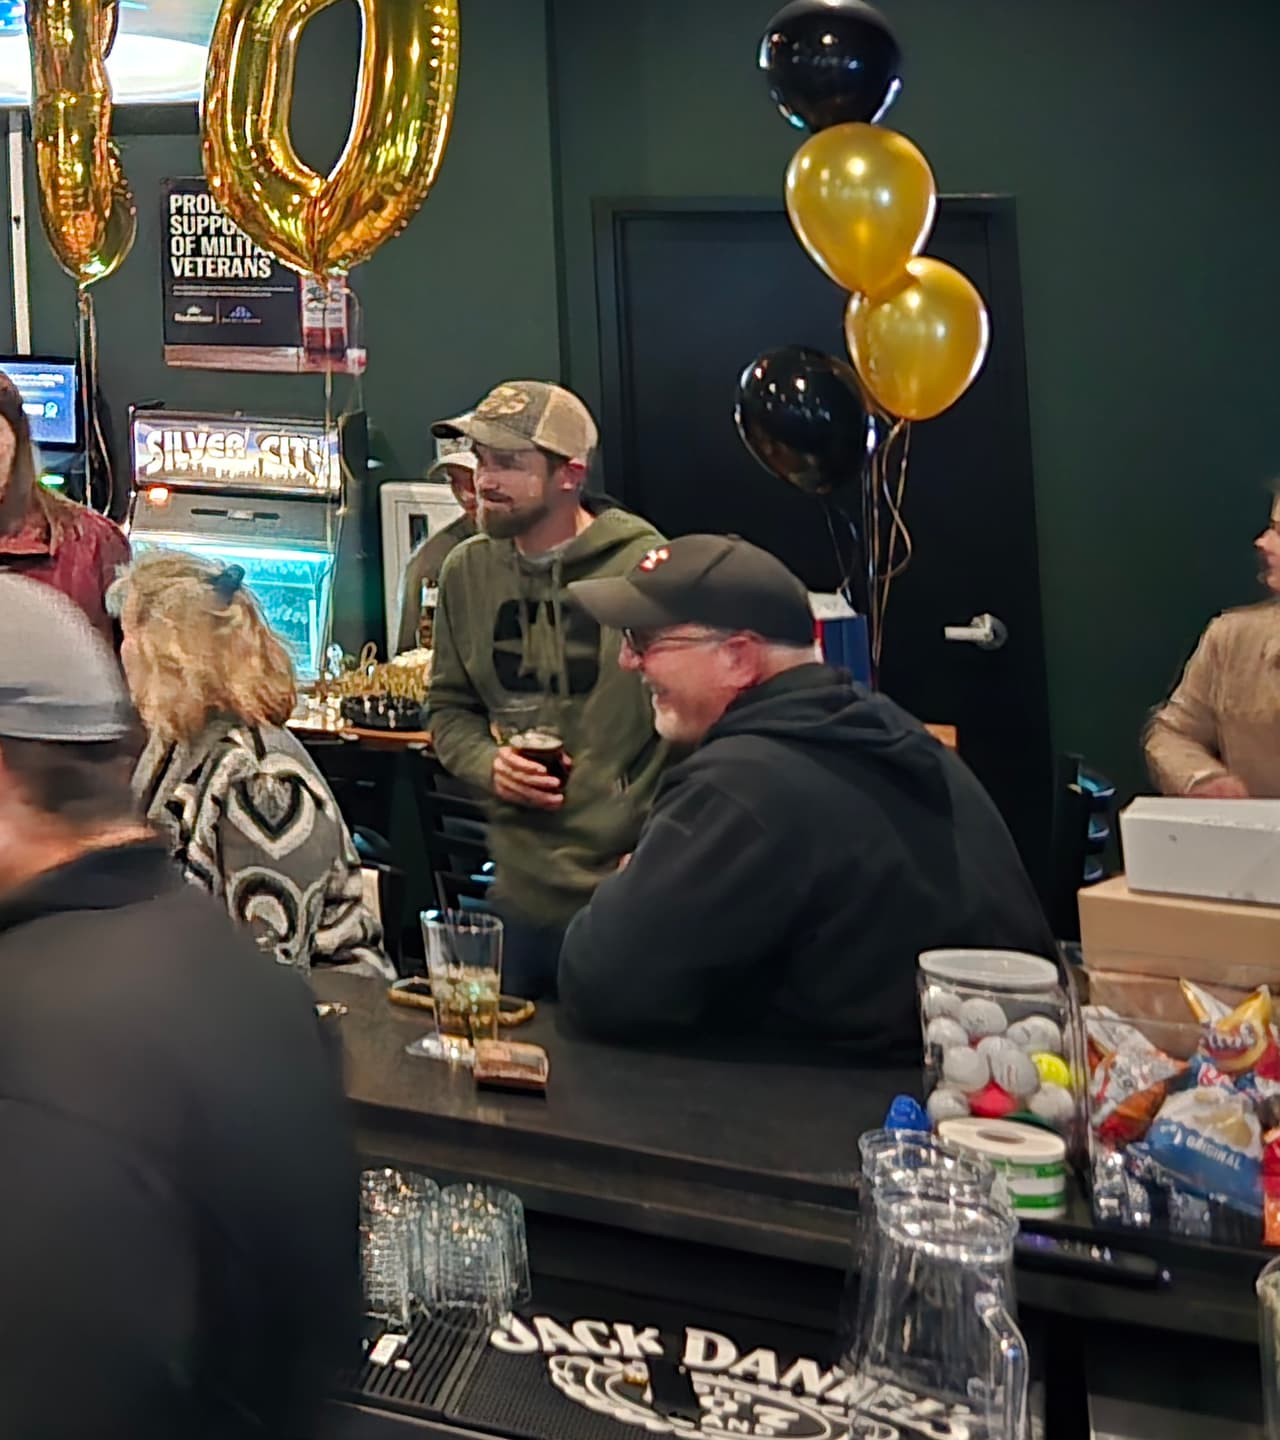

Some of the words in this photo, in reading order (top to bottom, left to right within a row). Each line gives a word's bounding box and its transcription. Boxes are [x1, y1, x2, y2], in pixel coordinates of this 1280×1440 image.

[169, 193, 225, 215] PROU
[170, 235, 197, 256] OF
[200, 236, 276, 260] MILITA
[170, 256, 272, 279] VETERANS
[146, 430, 249, 475] SILVER
[260, 434, 330, 488] CITY
[1186, 1134, 1241, 1171] ORIGINAL
[490, 1311, 664, 1358] JACK
